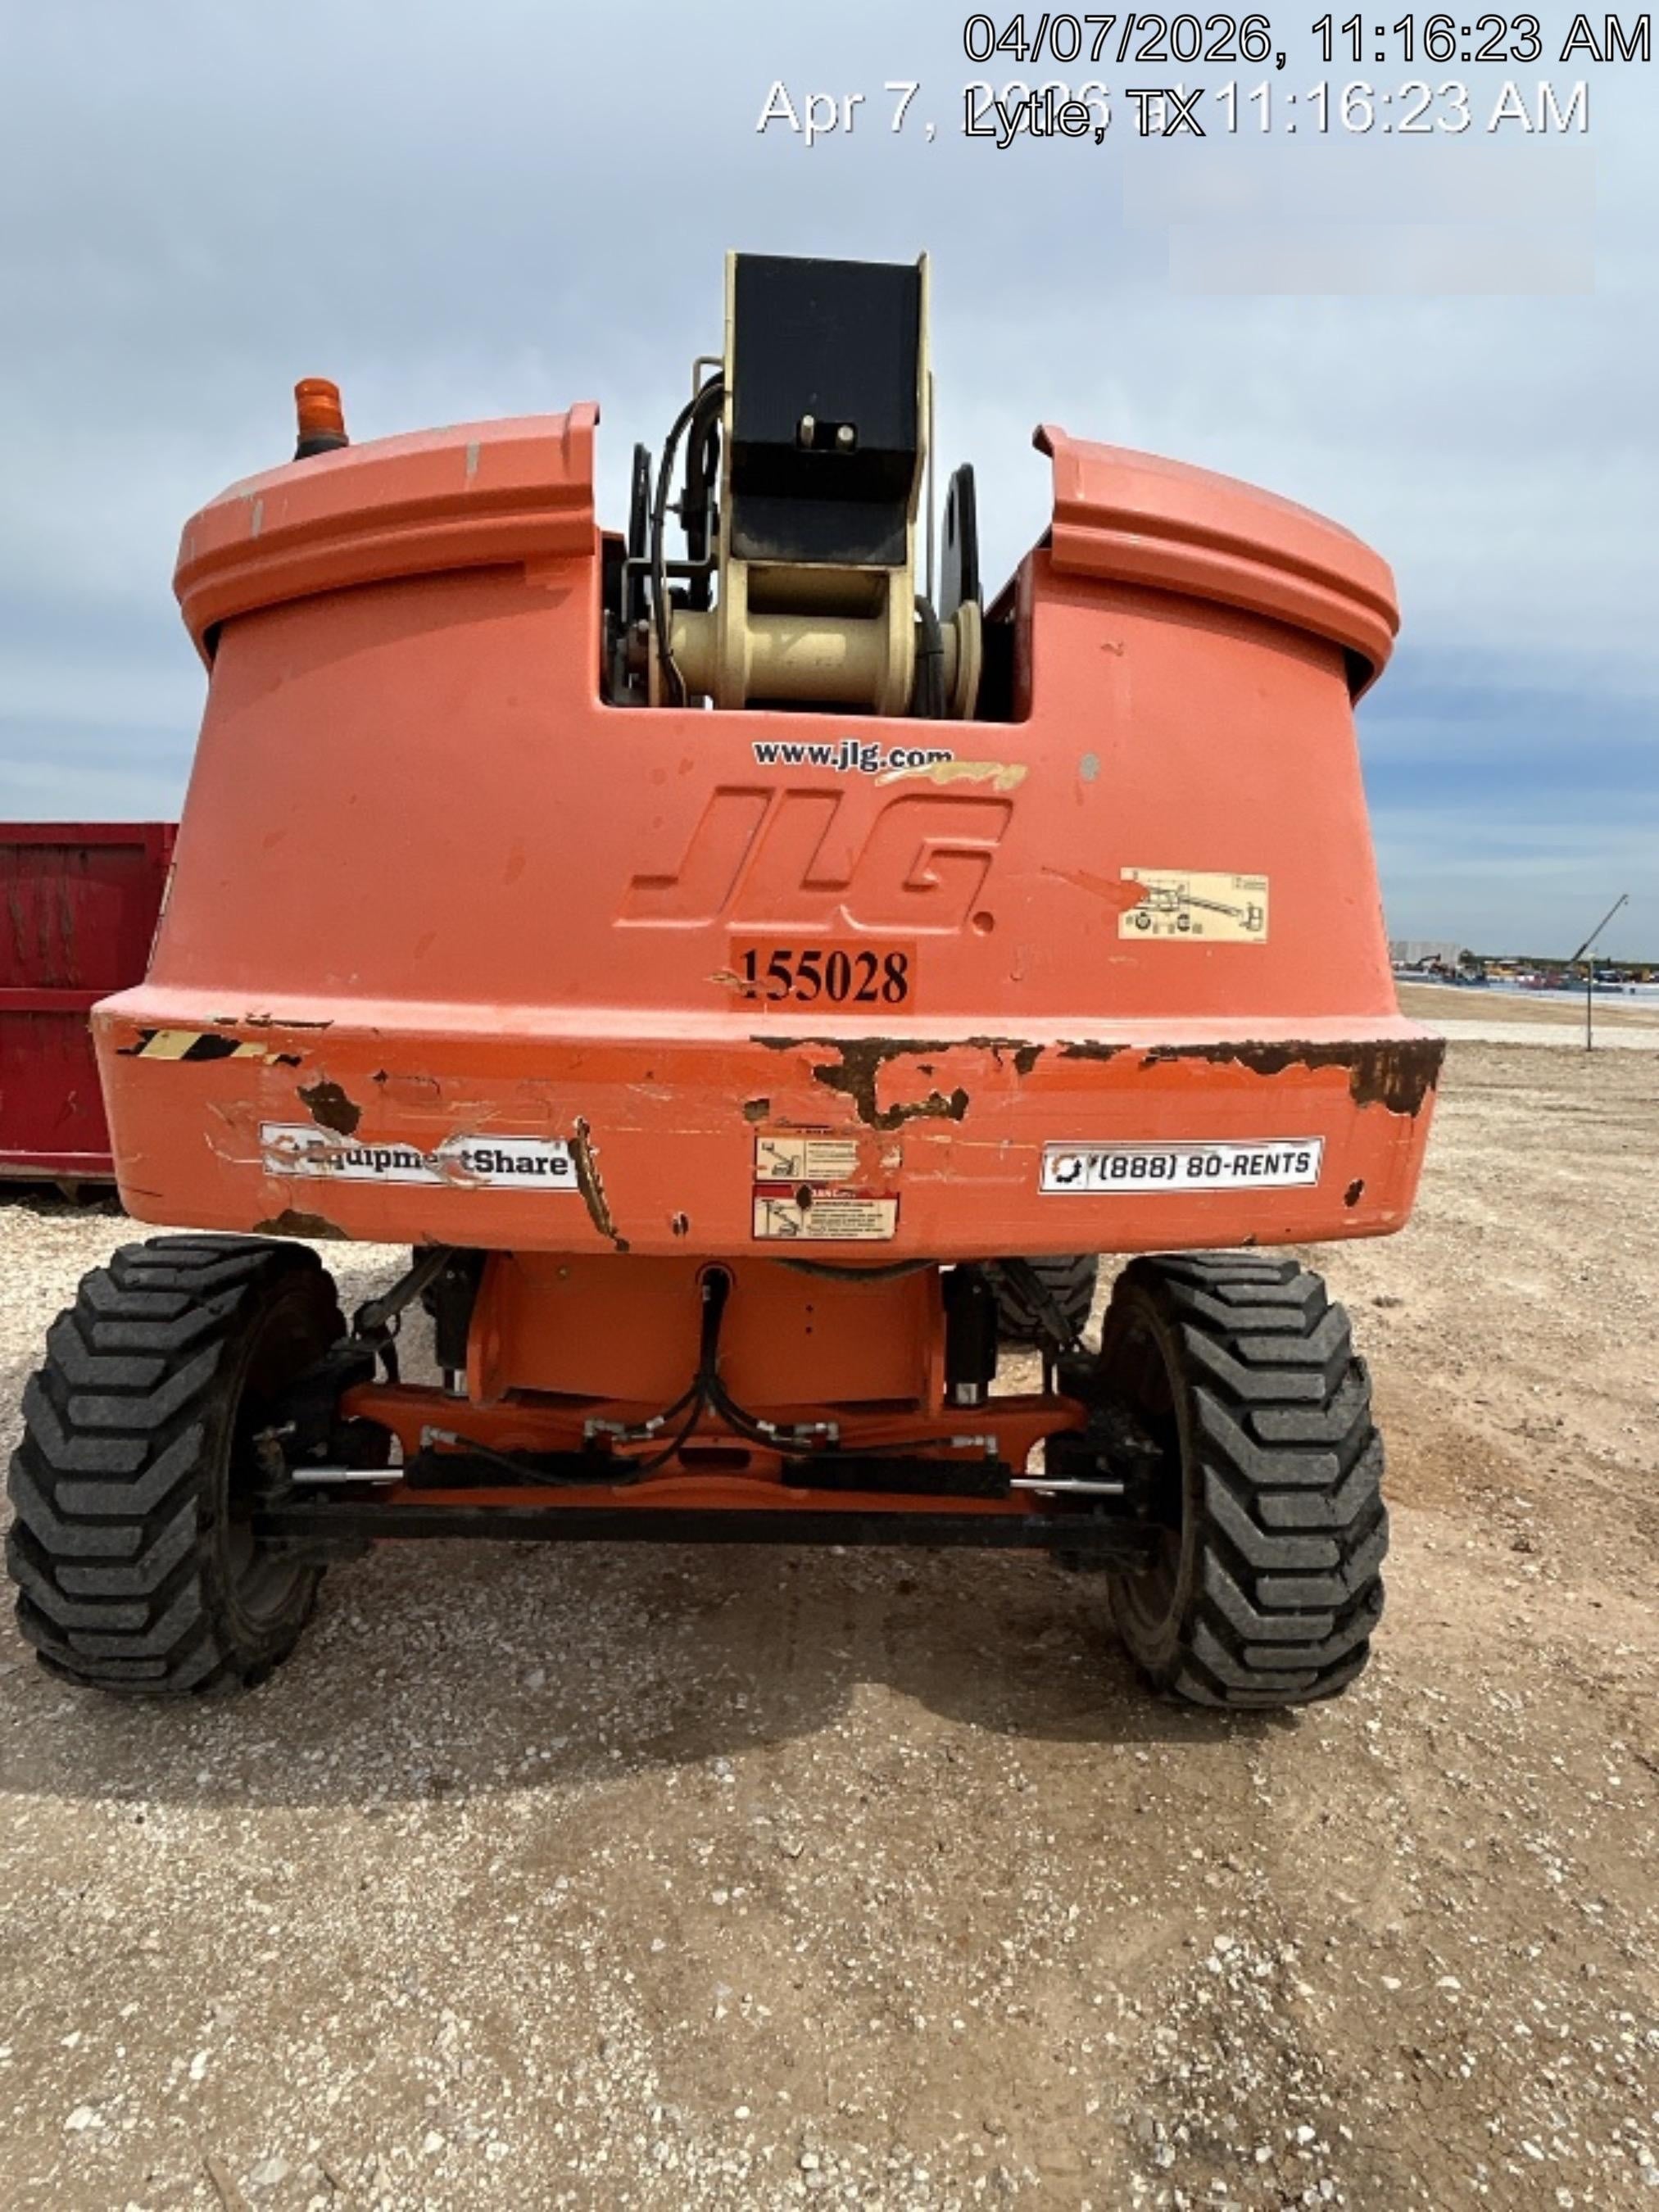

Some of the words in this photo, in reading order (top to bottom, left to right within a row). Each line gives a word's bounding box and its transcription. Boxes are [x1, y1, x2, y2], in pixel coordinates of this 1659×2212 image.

[754, 741, 952, 773] www.jlg.com
[613, 784, 1014, 935] JLG
[739, 949, 909, 1004] 155028
[1098, 1154, 1177, 1181] (888)
[1187, 1152, 1311, 1178] 80-RENTS
